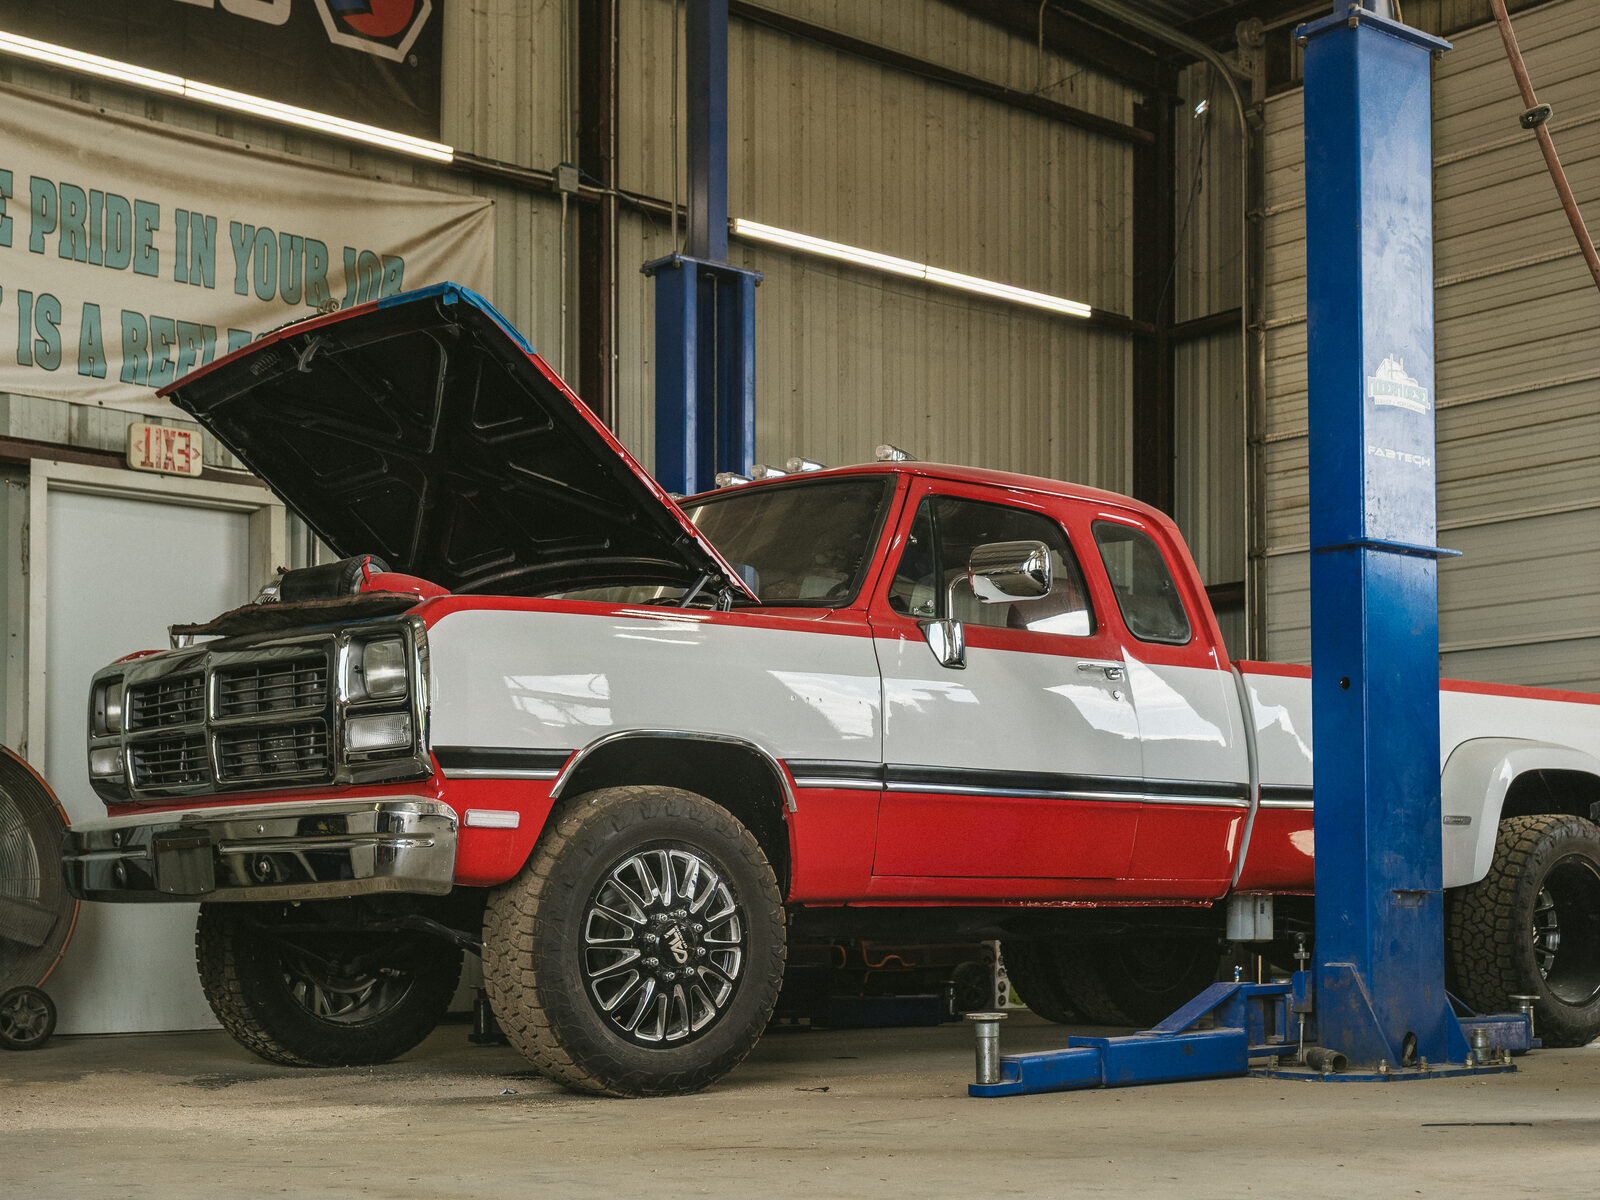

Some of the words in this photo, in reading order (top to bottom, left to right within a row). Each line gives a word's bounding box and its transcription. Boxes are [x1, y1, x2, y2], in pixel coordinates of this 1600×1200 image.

[29, 175, 160, 278] PRIDE
[174, 208, 217, 289] IN
[229, 220, 331, 309] YOUR
[17, 289, 62, 372] IS
[77, 302, 107, 380] A
[1367, 445, 1431, 469] FABTECH
